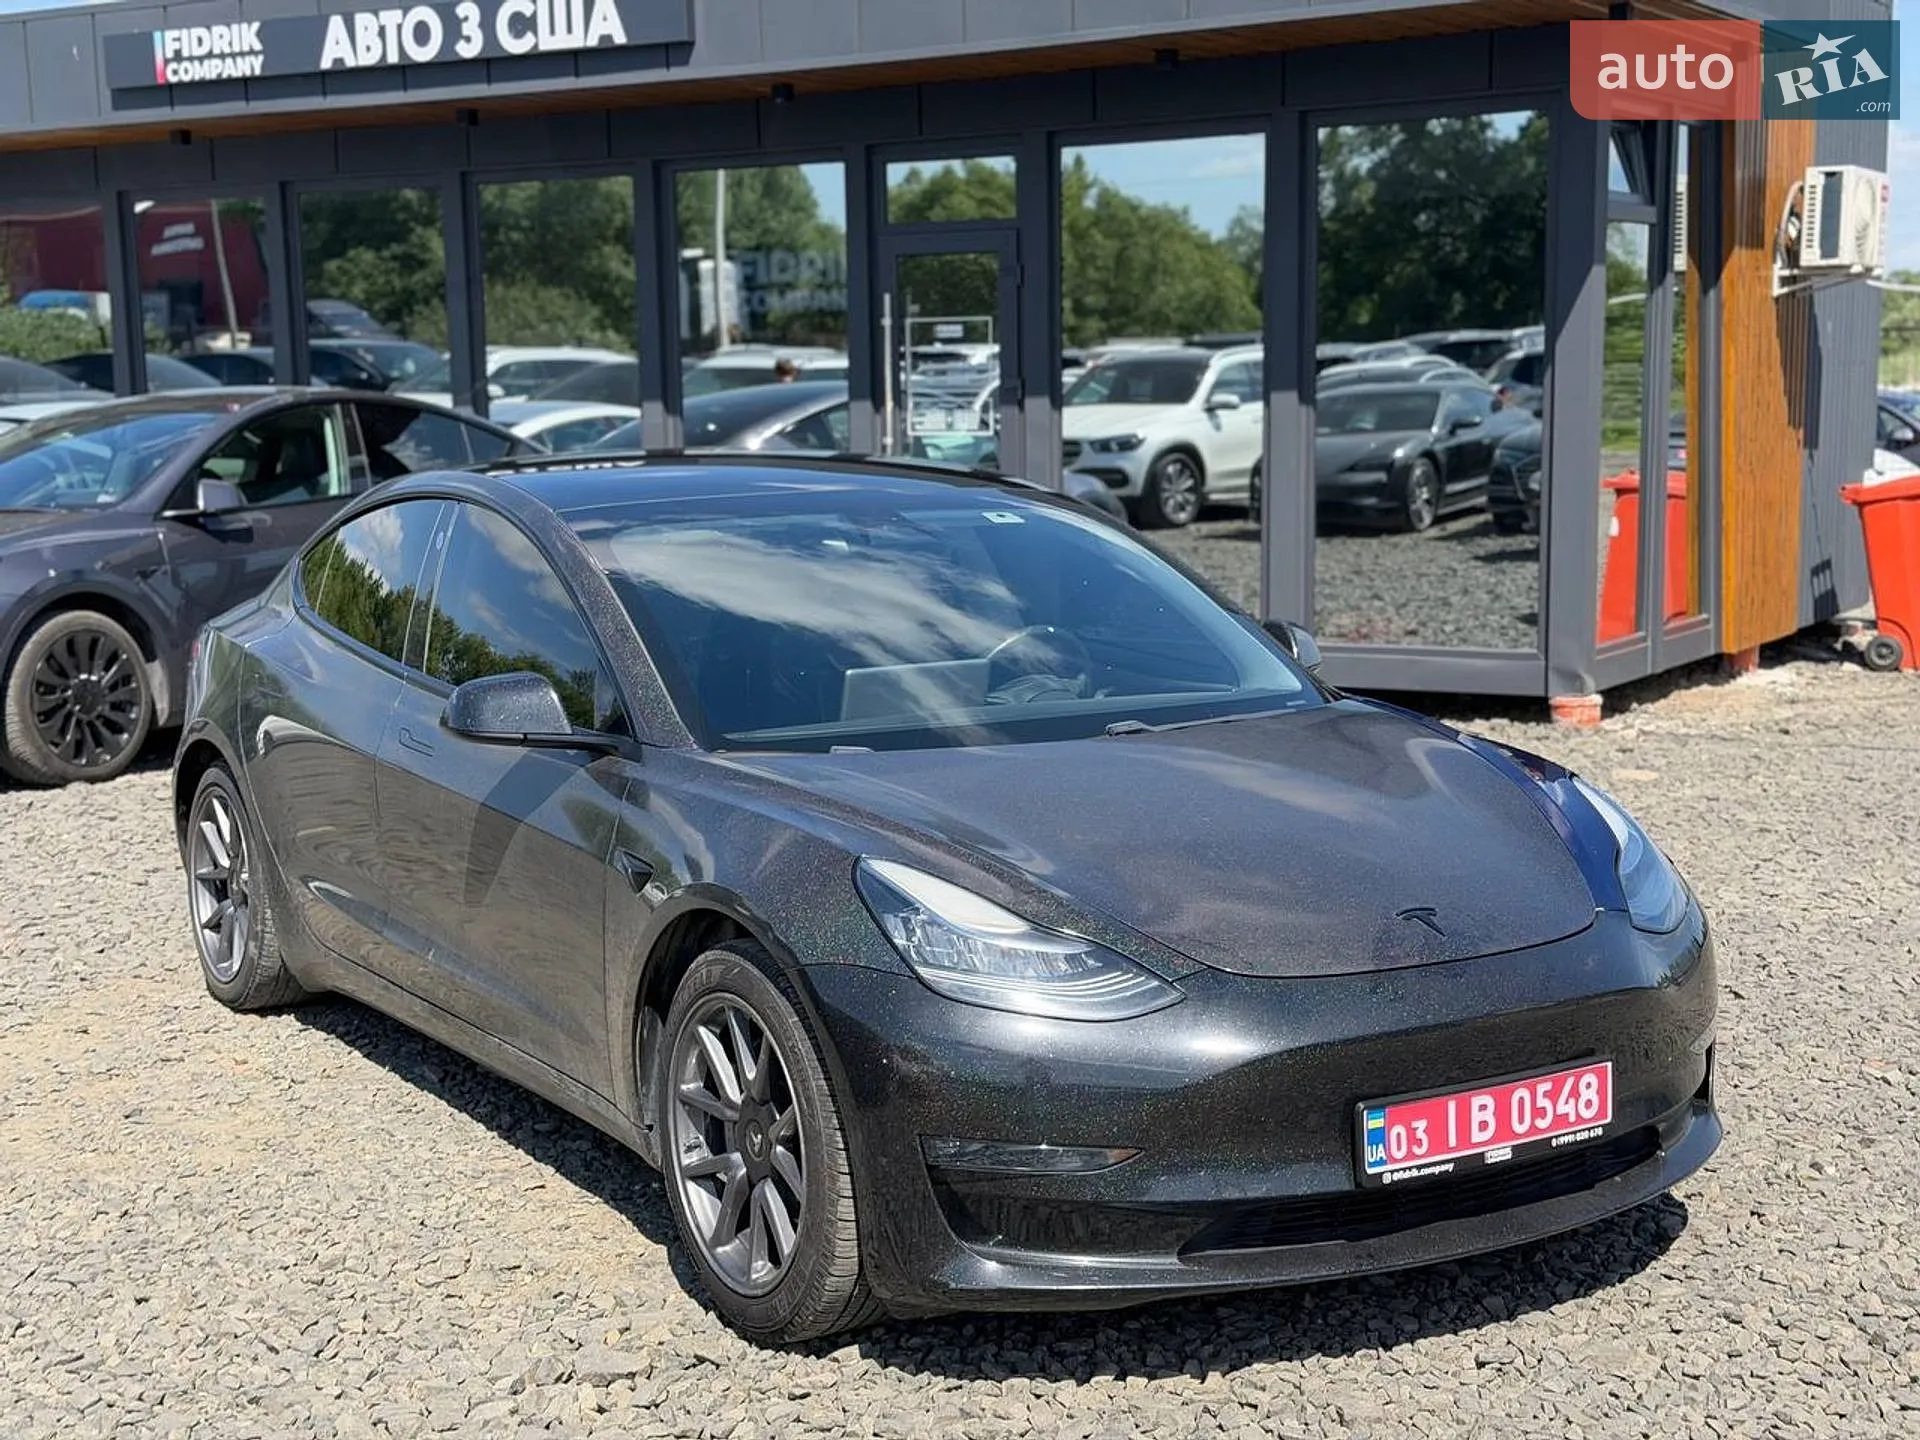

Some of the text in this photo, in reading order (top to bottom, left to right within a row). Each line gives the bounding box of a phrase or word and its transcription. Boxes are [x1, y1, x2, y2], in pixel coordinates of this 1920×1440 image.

[164, 21, 263, 59] FIDRIK
[320, 5, 444, 69] АВТО
[496, 0, 628, 55] США
[165, 54, 264, 83] COMPANY
[737, 248, 847, 286] FIDRI
[1389, 1118, 1430, 1160] 03
[1510, 1073, 1600, 1135] 0548
[1367, 1143, 1387, 1163] UA
